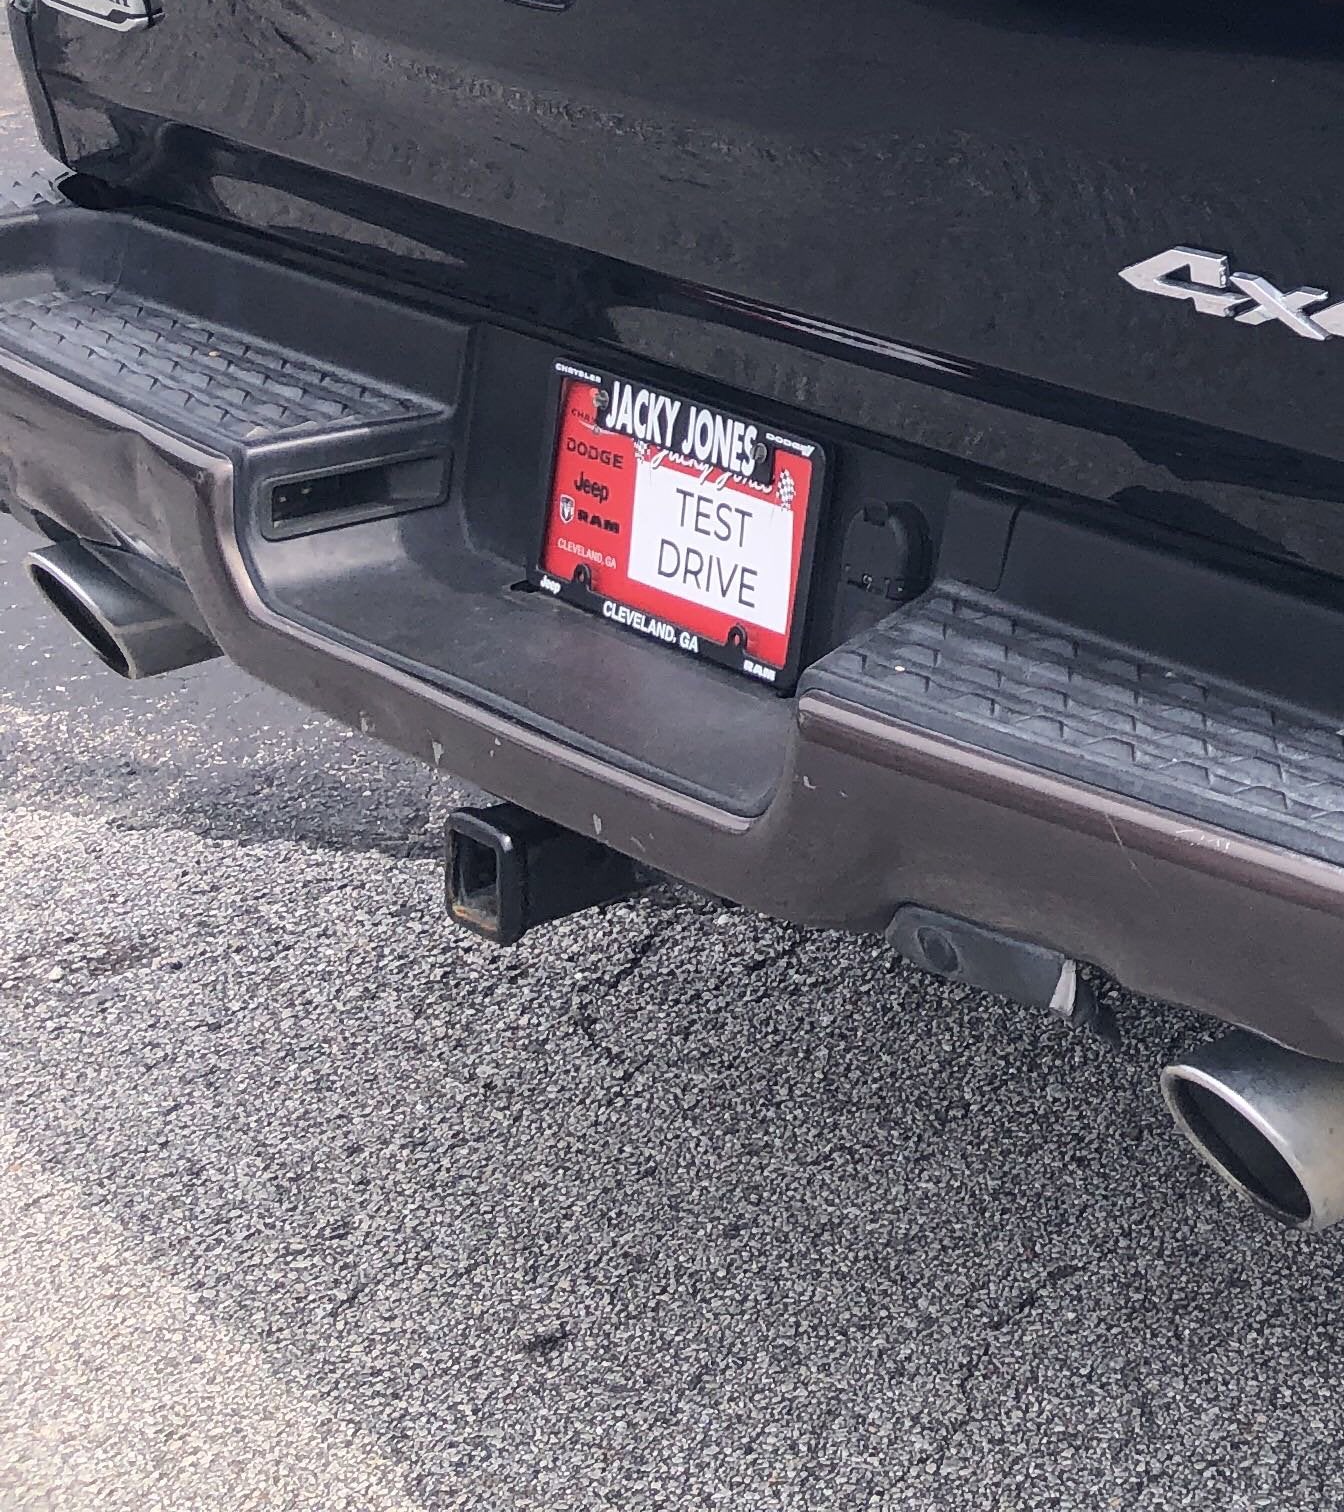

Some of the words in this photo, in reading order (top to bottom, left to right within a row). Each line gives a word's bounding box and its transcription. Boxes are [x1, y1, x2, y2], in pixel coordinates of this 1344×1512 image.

[555, 363, 602, 384] CHRYSLER
[605, 380, 681, 448] JACKY
[682, 405, 758, 477] JONES
[566, 437, 624, 470] DODGE
[574, 472, 609, 504] Jeep
[577, 509, 620, 534] RAM
[676, 487, 753, 548] TEST
[604, 555, 617, 569] GA
[657, 538, 759, 609] DRIVE
[540, 575, 561, 595] Jeep
[602, 600, 677, 644] CLEVELAND,
[679, 631, 699, 653] GA
[743, 659, 777, 682] RAM
